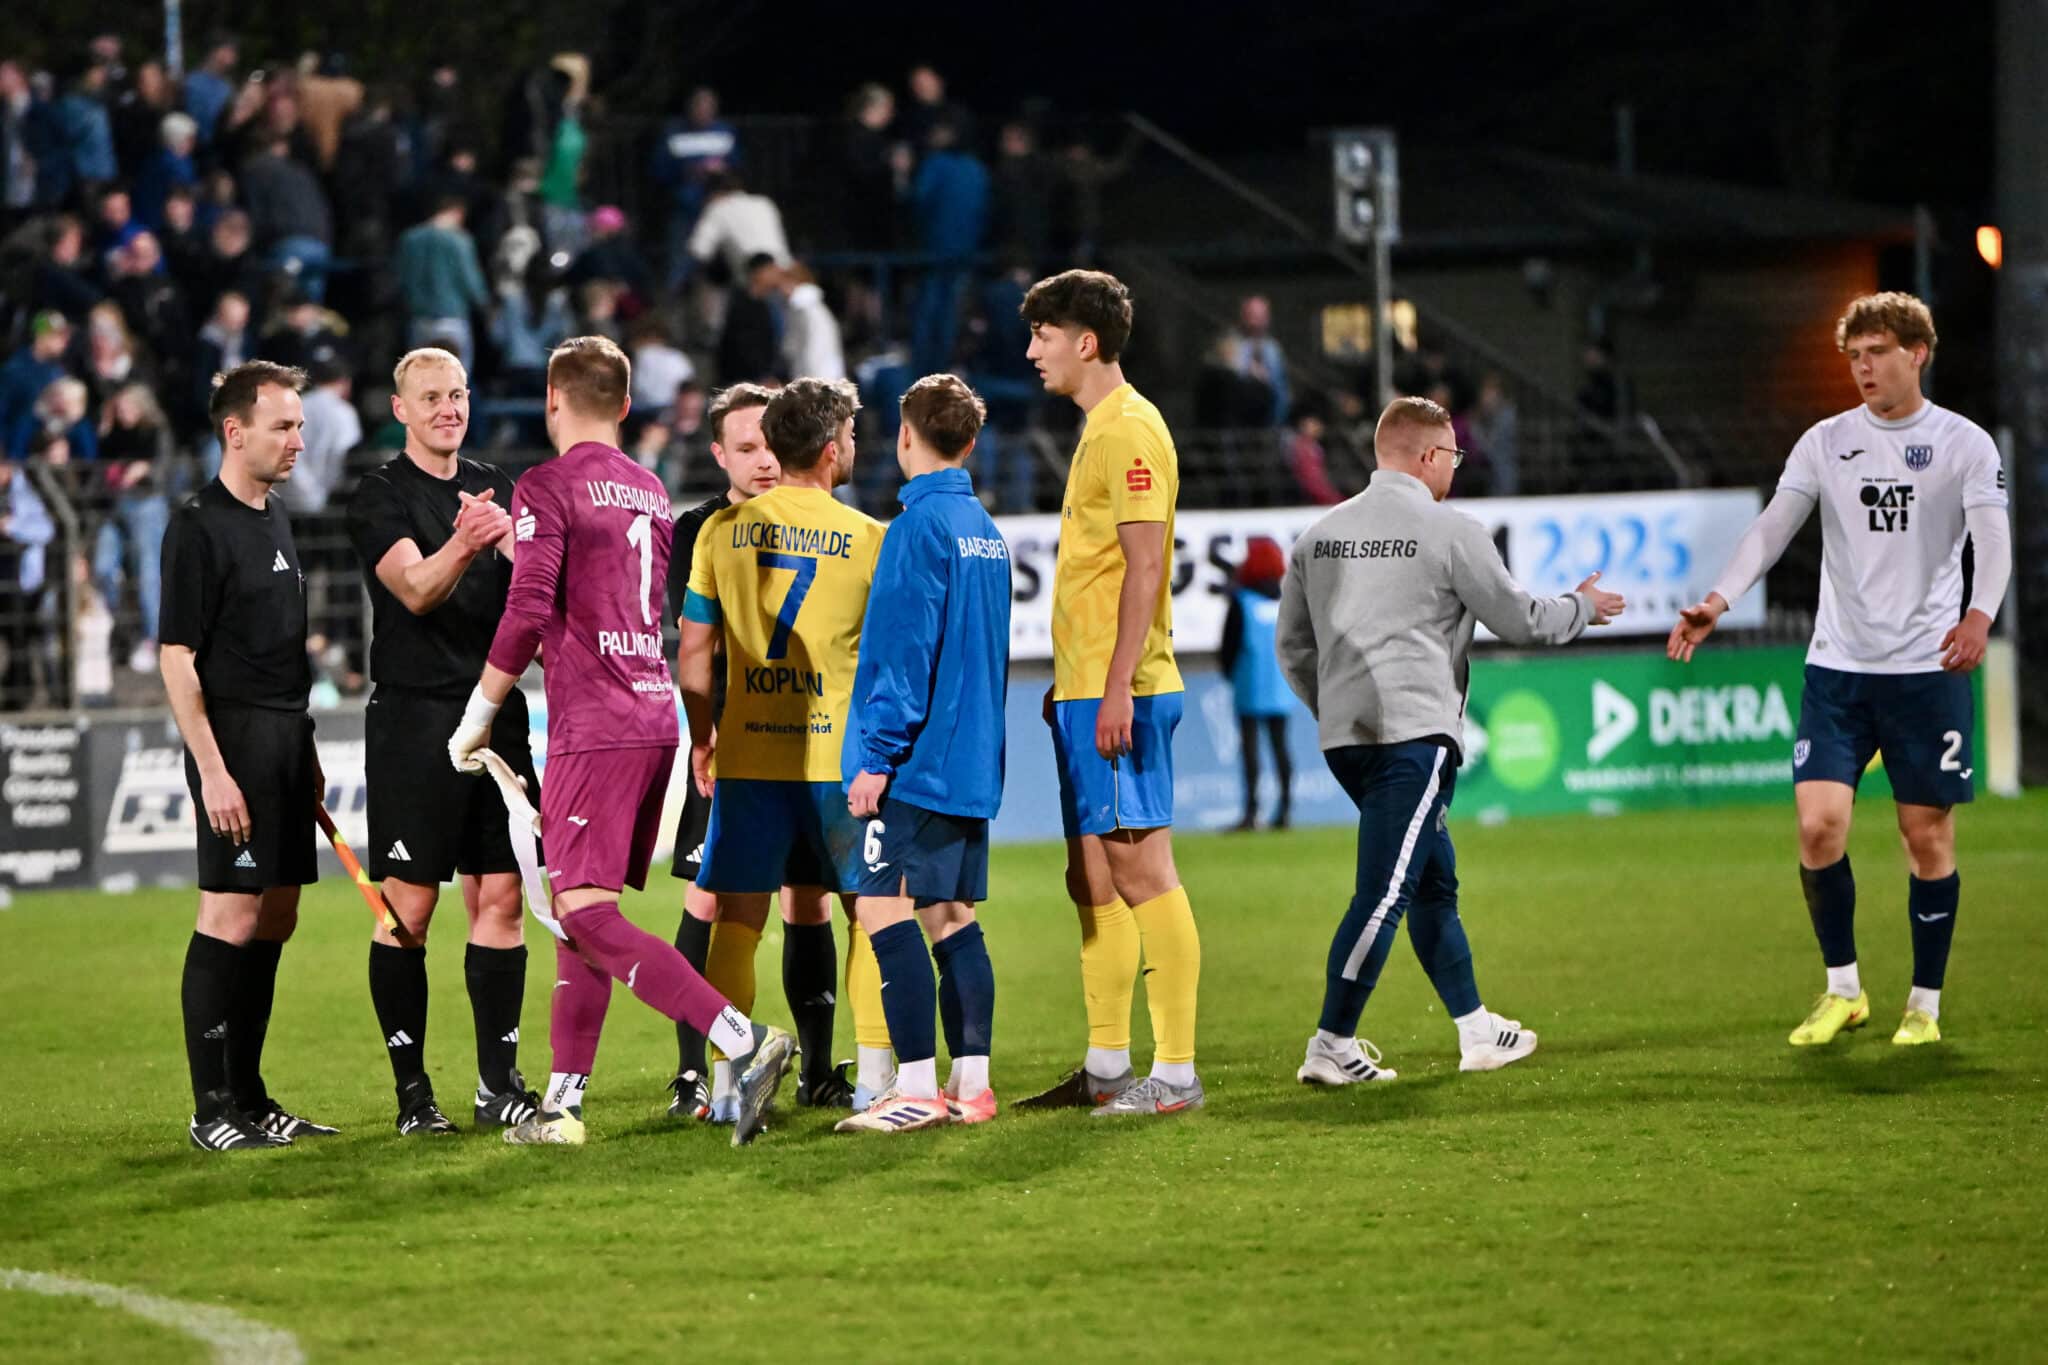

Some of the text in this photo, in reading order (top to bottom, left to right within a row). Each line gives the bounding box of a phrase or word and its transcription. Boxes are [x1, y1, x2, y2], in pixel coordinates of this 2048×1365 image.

[732, 522, 853, 559] LUCKENWALDE
[1313, 539, 1418, 559] BABELSBERG
[626, 514, 652, 625] 1
[757, 551, 817, 659] 7
[745, 667, 823, 697] KOPLIN
[810, 722, 832, 734] Hof
[1650, 681, 1794, 747] DEKRA
[1940, 730, 1963, 772] 2
[864, 819, 885, 865] 6
